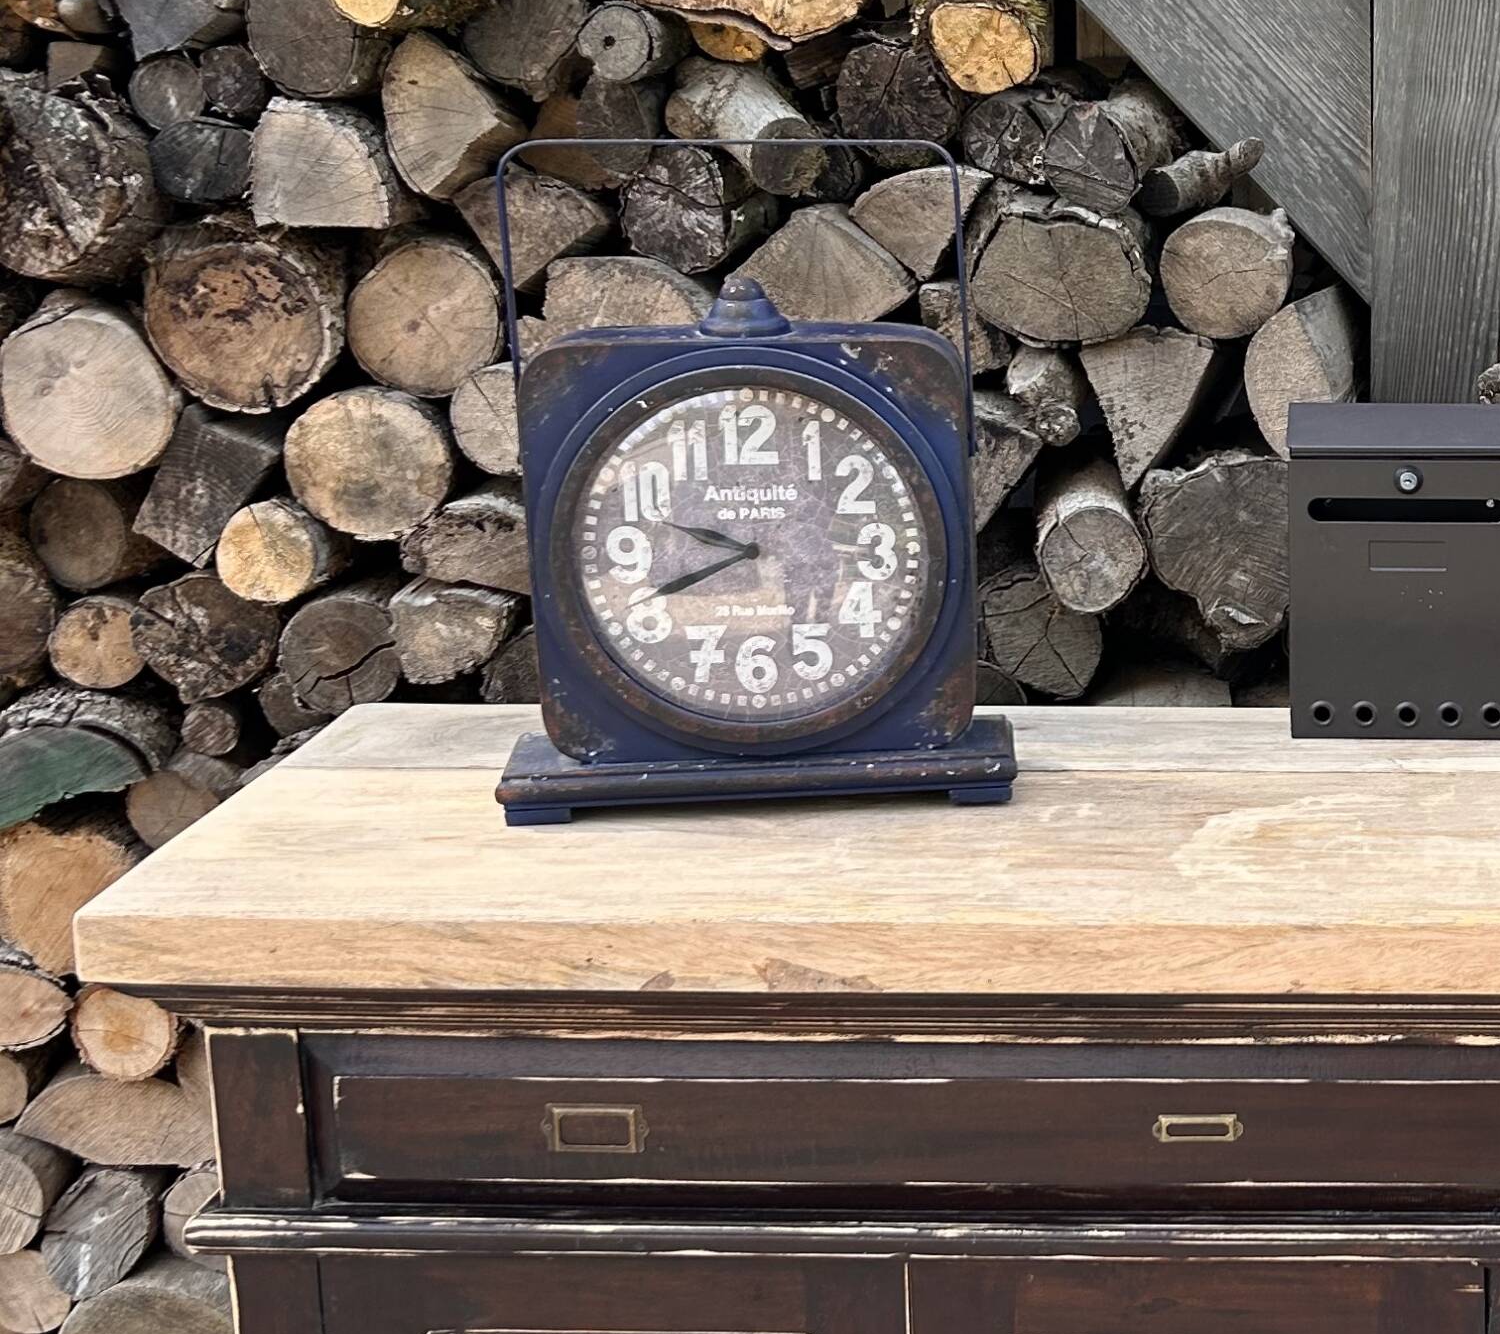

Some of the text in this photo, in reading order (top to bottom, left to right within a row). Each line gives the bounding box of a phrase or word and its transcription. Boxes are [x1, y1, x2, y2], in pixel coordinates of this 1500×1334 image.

[667, 419, 708, 481] 11
[719, 405, 780, 465] 12
[803, 419, 822, 481] 1
[620, 461, 671, 522] 10
[704, 484, 798, 505] Antiquité
[717, 507, 786, 520] de PARIS
[835, 455, 876, 515] 2
[606, 526, 654, 584] 9
[856, 522, 897, 581] 3
[626, 587, 674, 644] 8
[838, 582, 882, 639] 4
[684, 624, 726, 683] 7
[736, 635, 778, 692] 6
[792, 623, 834, 681] 5
